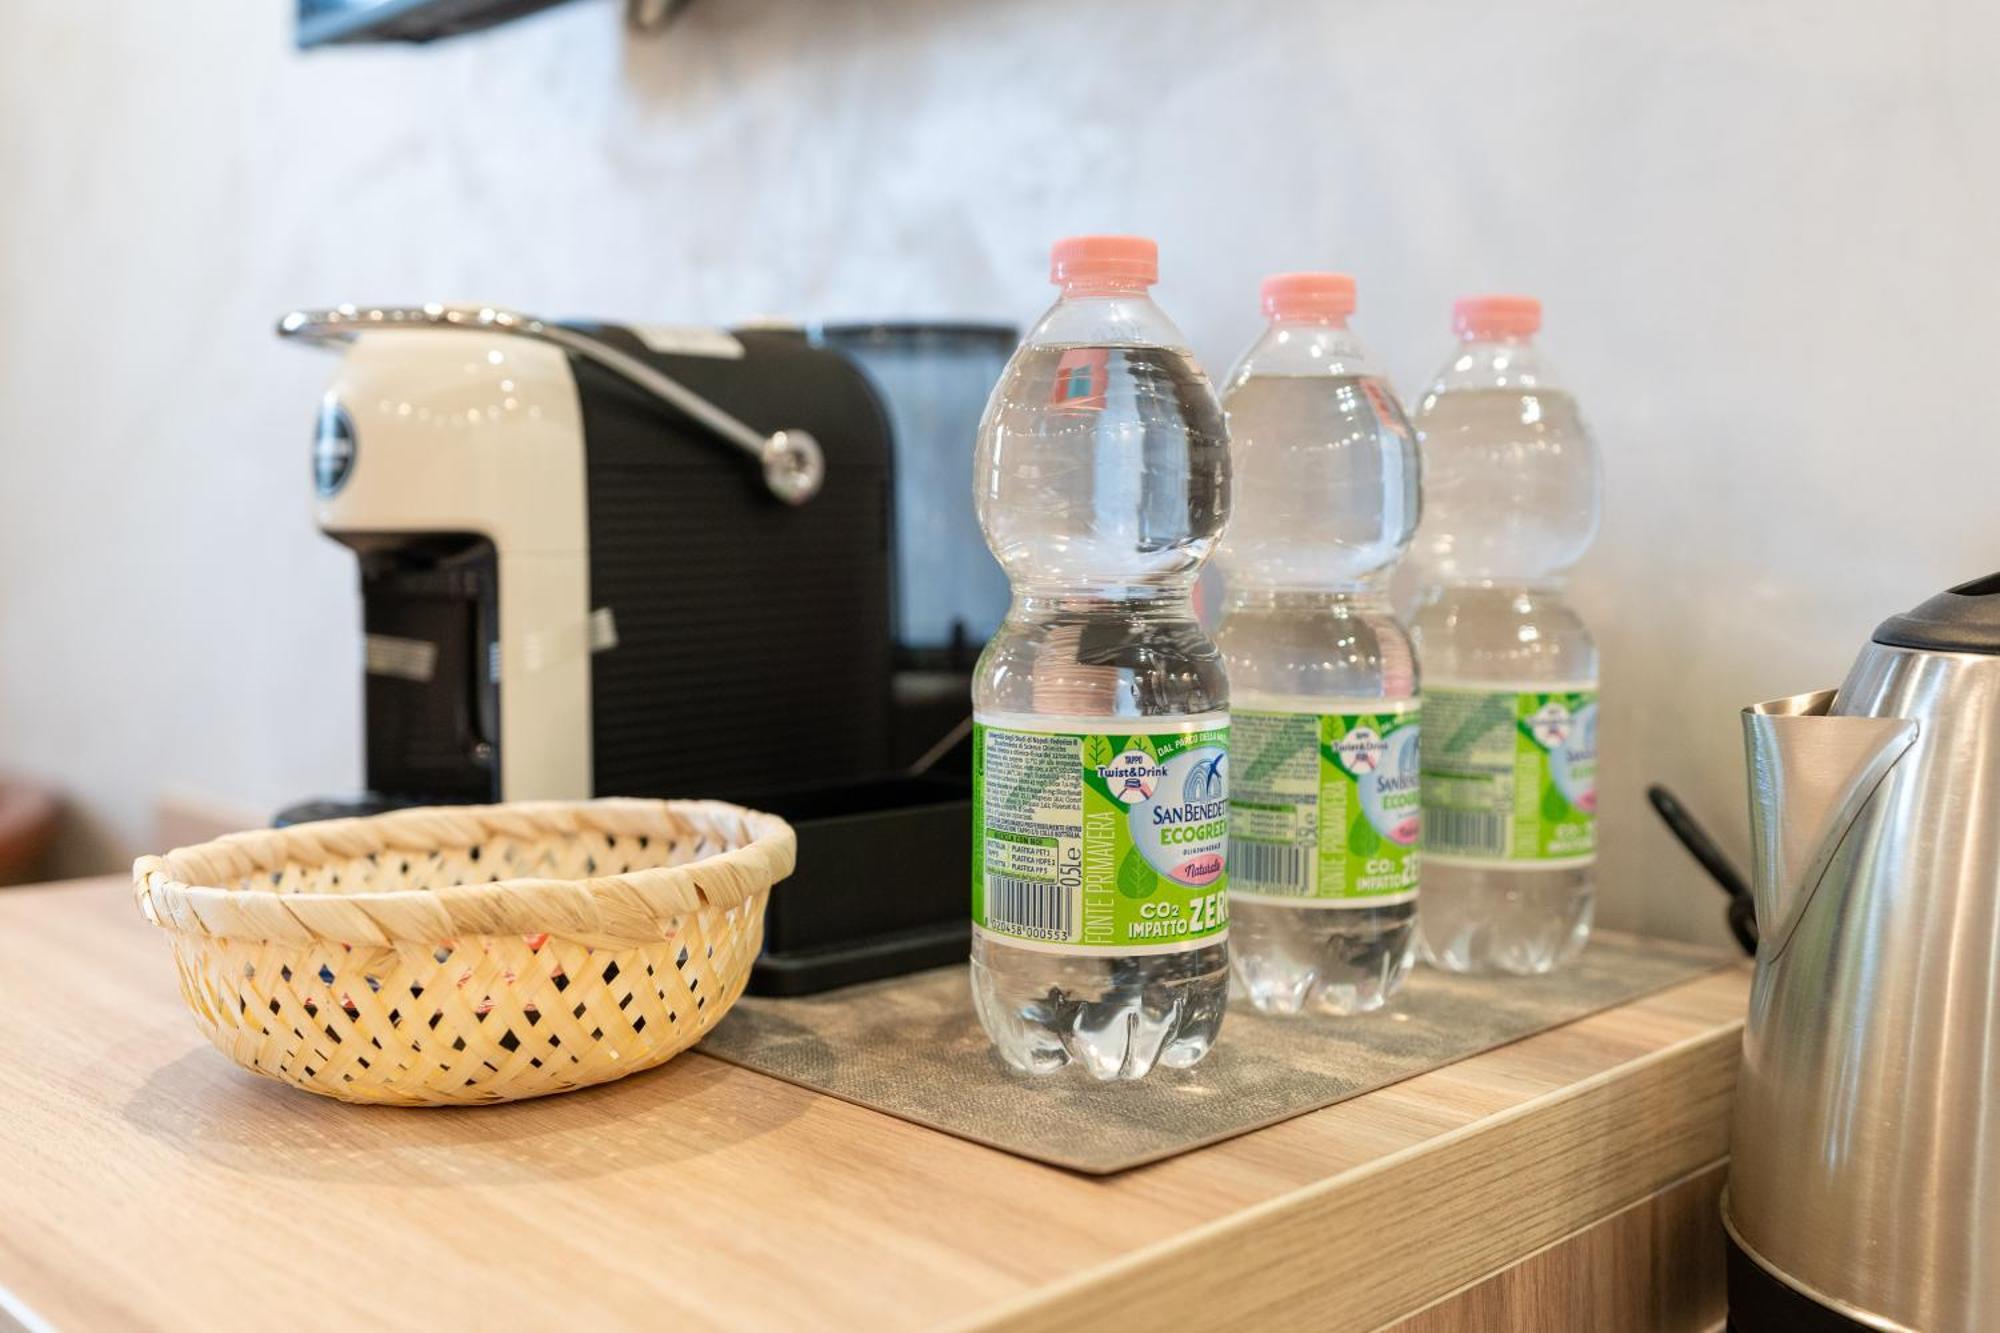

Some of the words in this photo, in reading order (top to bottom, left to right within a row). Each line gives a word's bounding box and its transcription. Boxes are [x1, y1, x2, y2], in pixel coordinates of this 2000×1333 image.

[1124, 755, 1143, 764] TAPPO
[1157, 746, 1173, 757] DAL
[1097, 766, 1168, 778] Twist&Drink
[1153, 805, 1182, 825] SAN
[1085, 811, 1115, 894] PRIMAVERA
[1085, 898, 1114, 944] FONTE
[1129, 919, 1187, 939] IMPATTO
[1026, 927, 1068, 942] 000553
